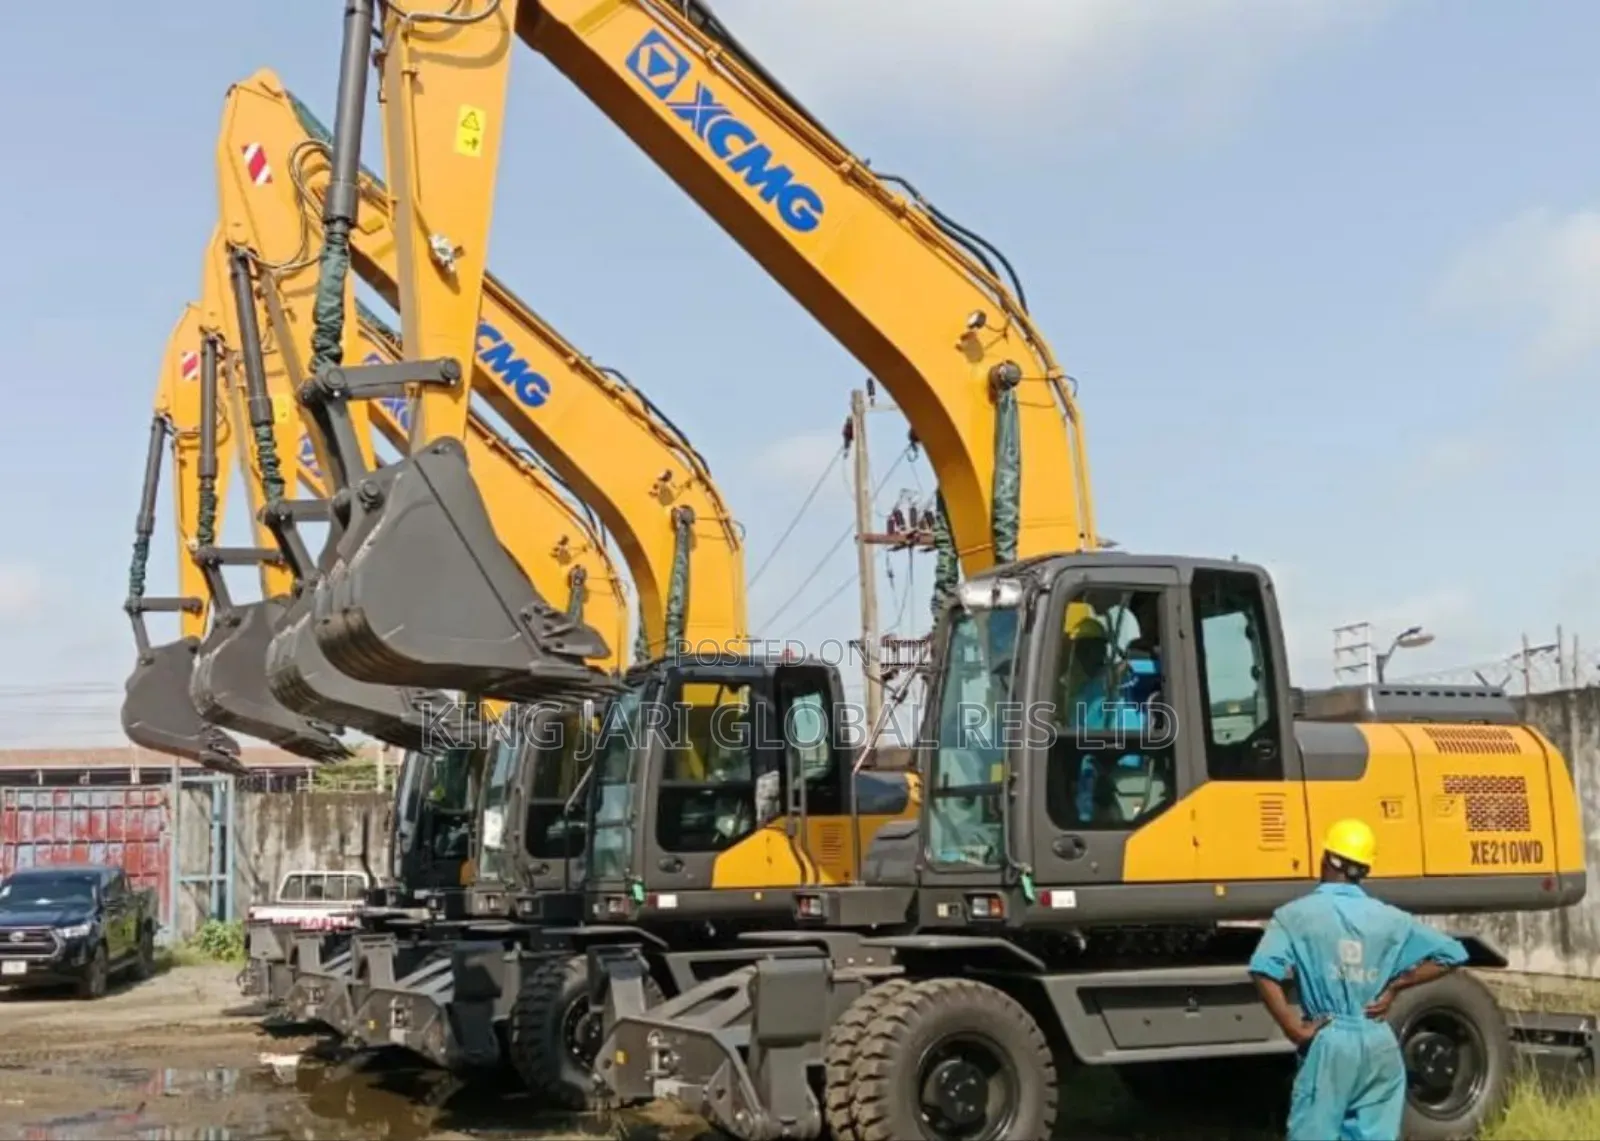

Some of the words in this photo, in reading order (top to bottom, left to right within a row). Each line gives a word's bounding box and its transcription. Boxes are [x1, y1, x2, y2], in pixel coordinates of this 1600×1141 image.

[665, 80, 824, 232] XCMG
[477, 319, 551, 408] CMG
[1470, 839, 1543, 865] XE210WD
